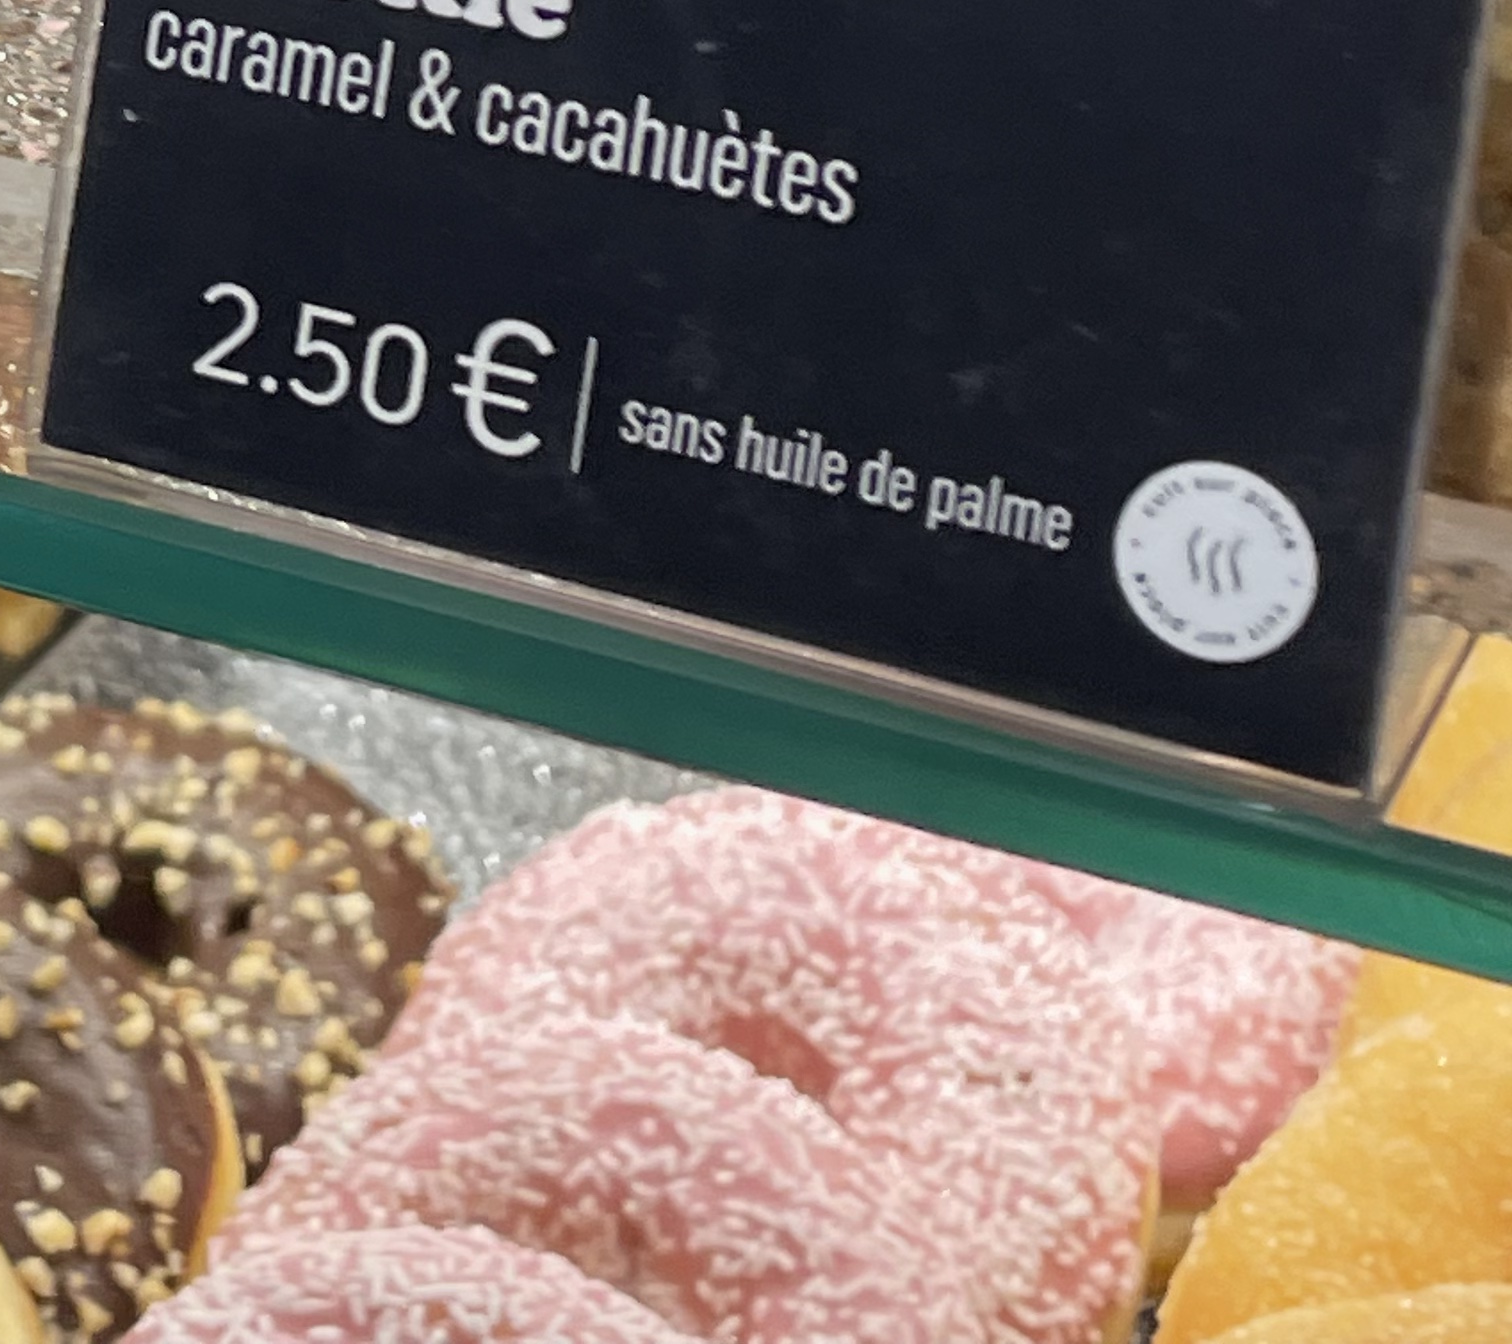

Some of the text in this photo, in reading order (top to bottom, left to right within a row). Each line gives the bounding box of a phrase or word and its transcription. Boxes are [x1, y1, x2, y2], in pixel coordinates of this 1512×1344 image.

[145, 10, 858, 223] caramel & cacahuètes
[192, 282, 428, 425] 2.50
[618, 400, 727, 464] sans
[735, 414, 848, 495] huile
[858, 449, 916, 512] de
[925, 476, 1073, 551] palme
